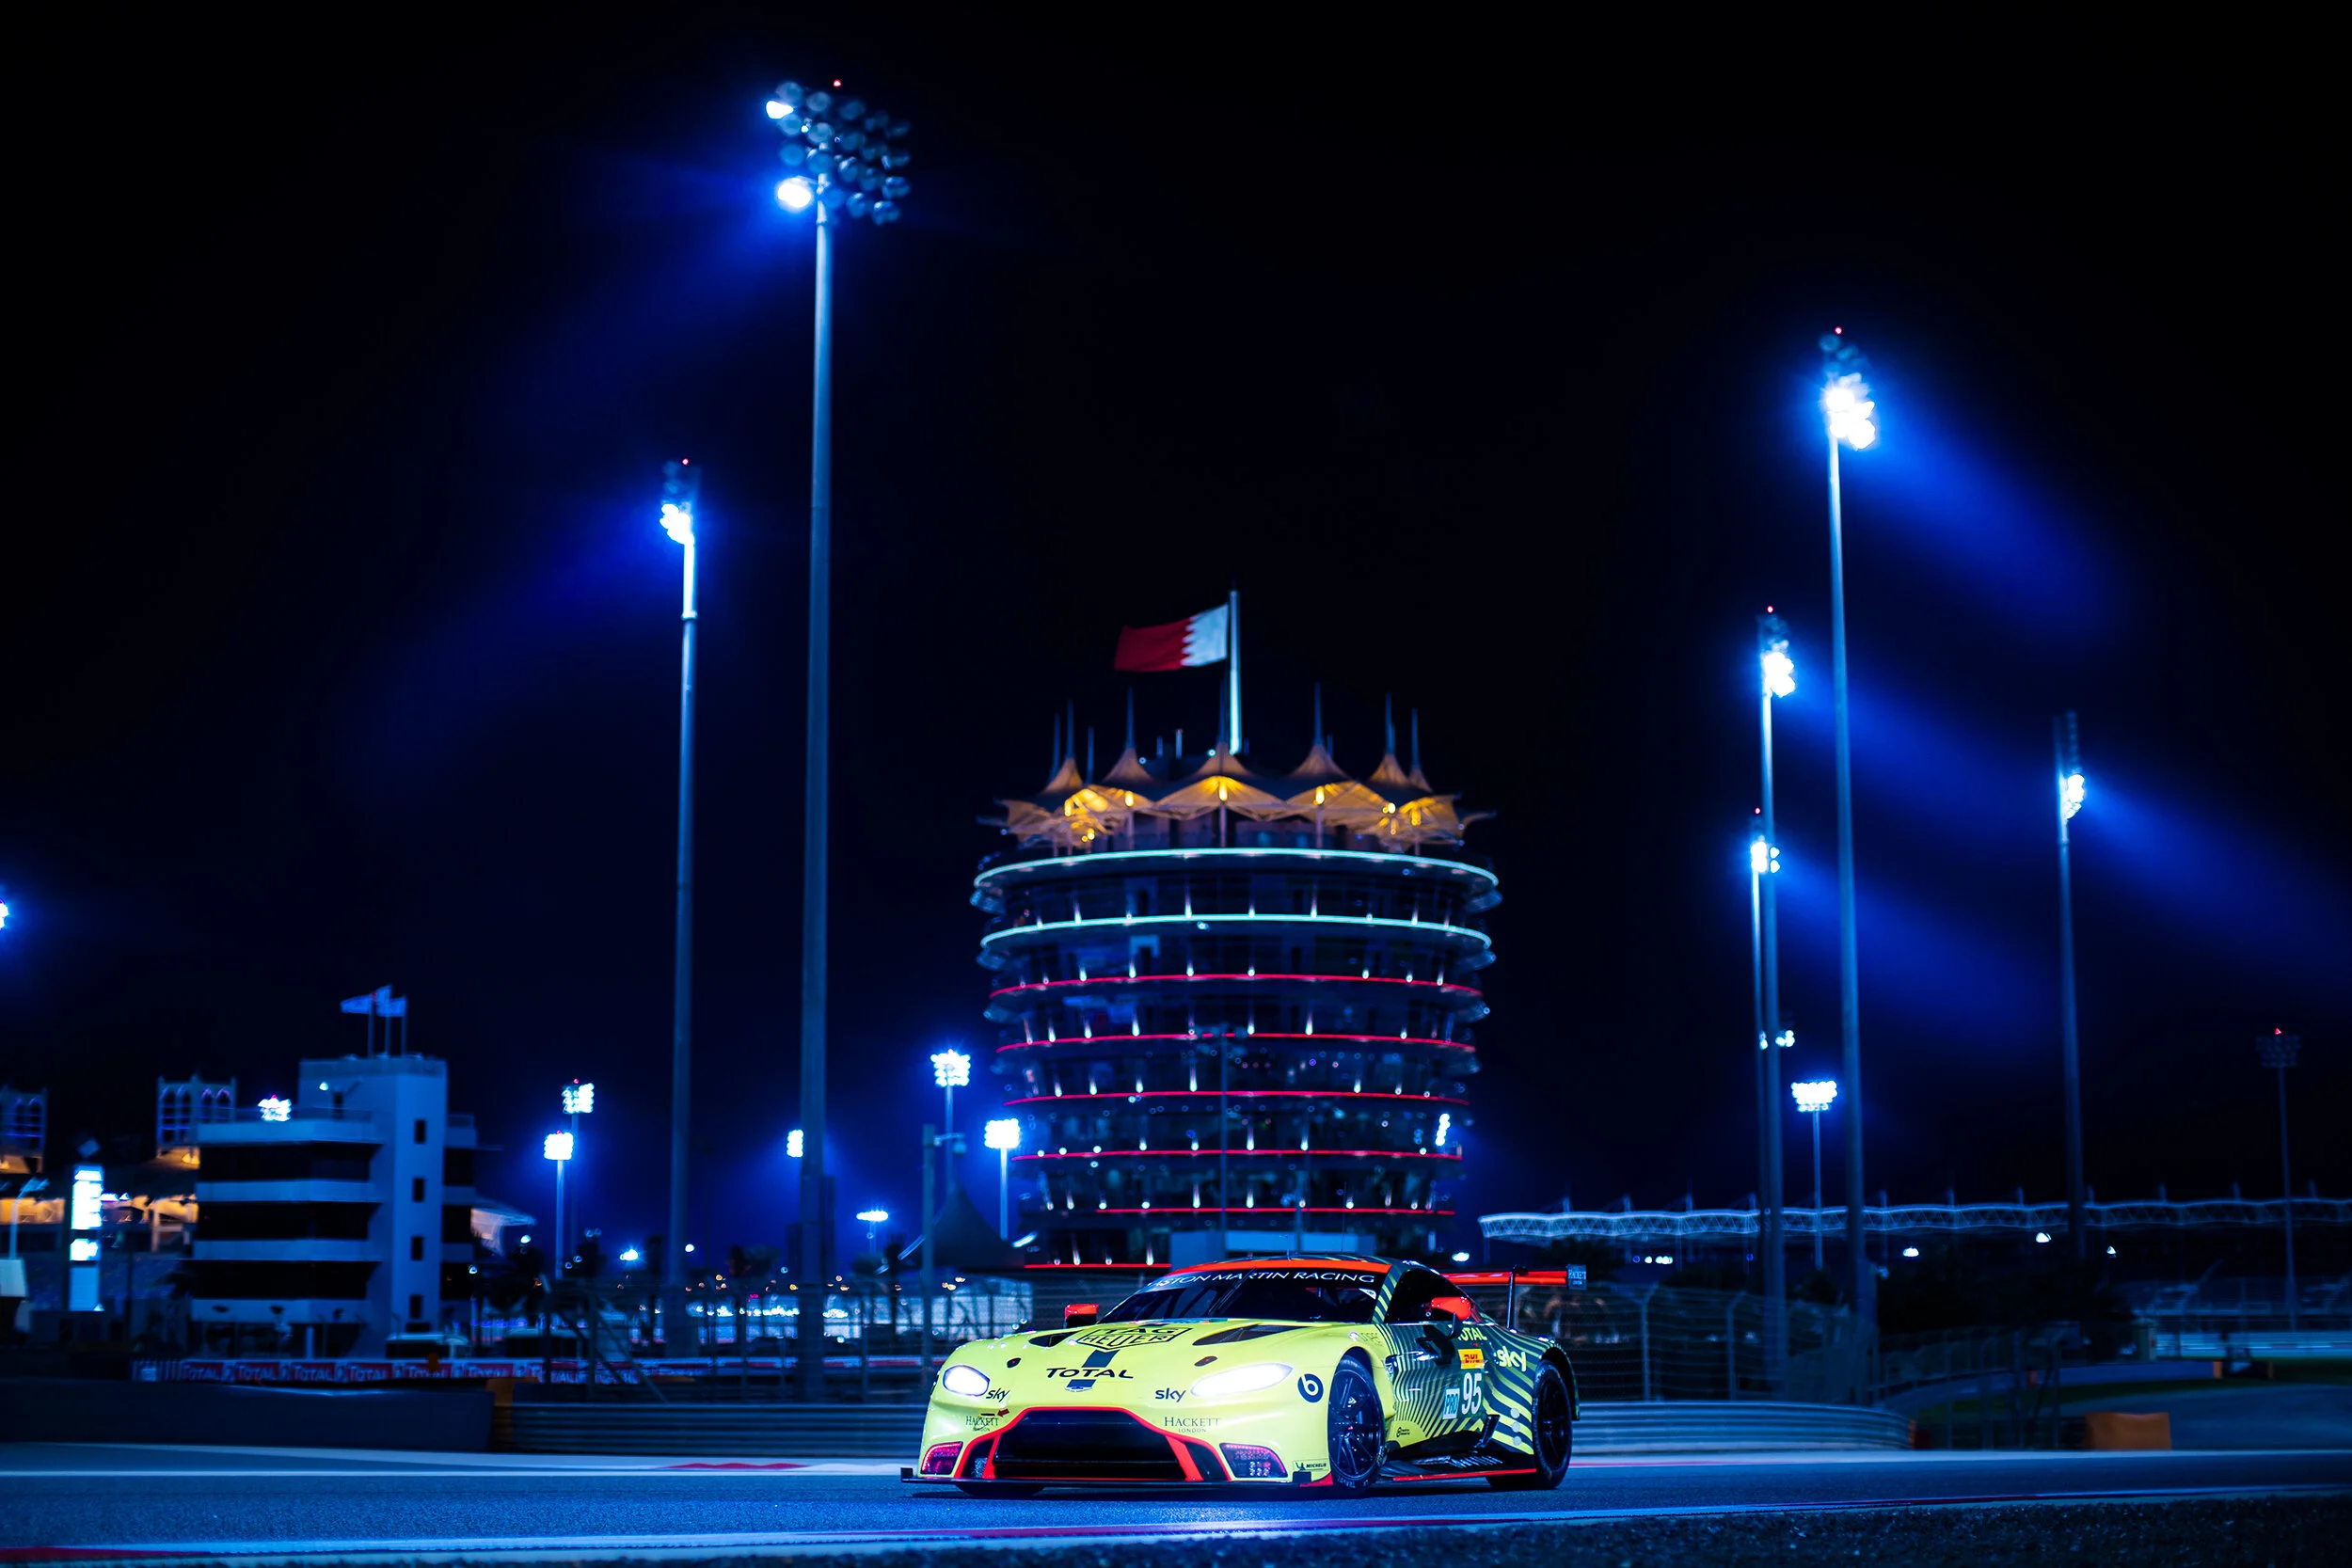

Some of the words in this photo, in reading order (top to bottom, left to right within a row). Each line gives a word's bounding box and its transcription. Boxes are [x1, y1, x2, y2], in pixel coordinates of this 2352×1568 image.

[1294, 1272, 1375, 1283] RACING
[1082, 1335, 1168, 1347] HEUER
[1457, 1327, 1487, 1341] OTAL
[1496, 1345, 1527, 1372] sky
[1046, 1367, 1135, 1380] TOTAL
[985, 1387, 1011, 1402] sky
[1154, 1387, 1187, 1402] sky
[1461, 1371, 1483, 1415] 95
[1443, 1393, 1458, 1416] PRO
[1164, 1416, 1221, 1427] HACKETT
